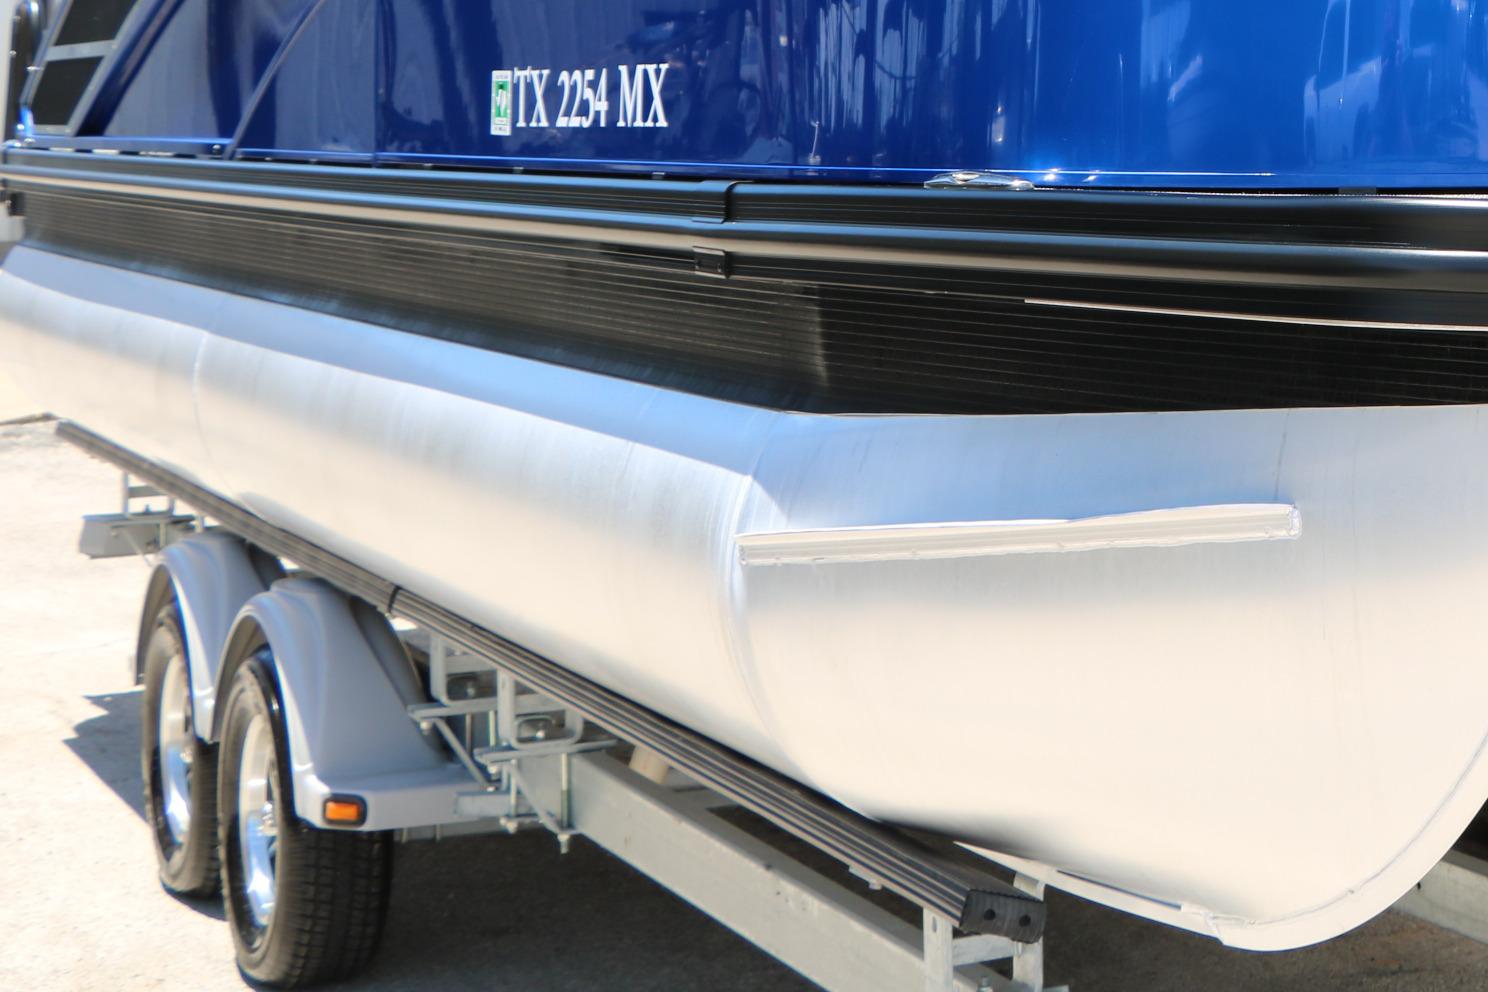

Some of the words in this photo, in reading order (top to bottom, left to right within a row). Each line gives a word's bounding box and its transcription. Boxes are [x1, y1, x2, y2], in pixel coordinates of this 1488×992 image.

[513, 66, 550, 128] TX
[555, 67, 609, 129] 2254
[616, 63, 670, 128] MX
